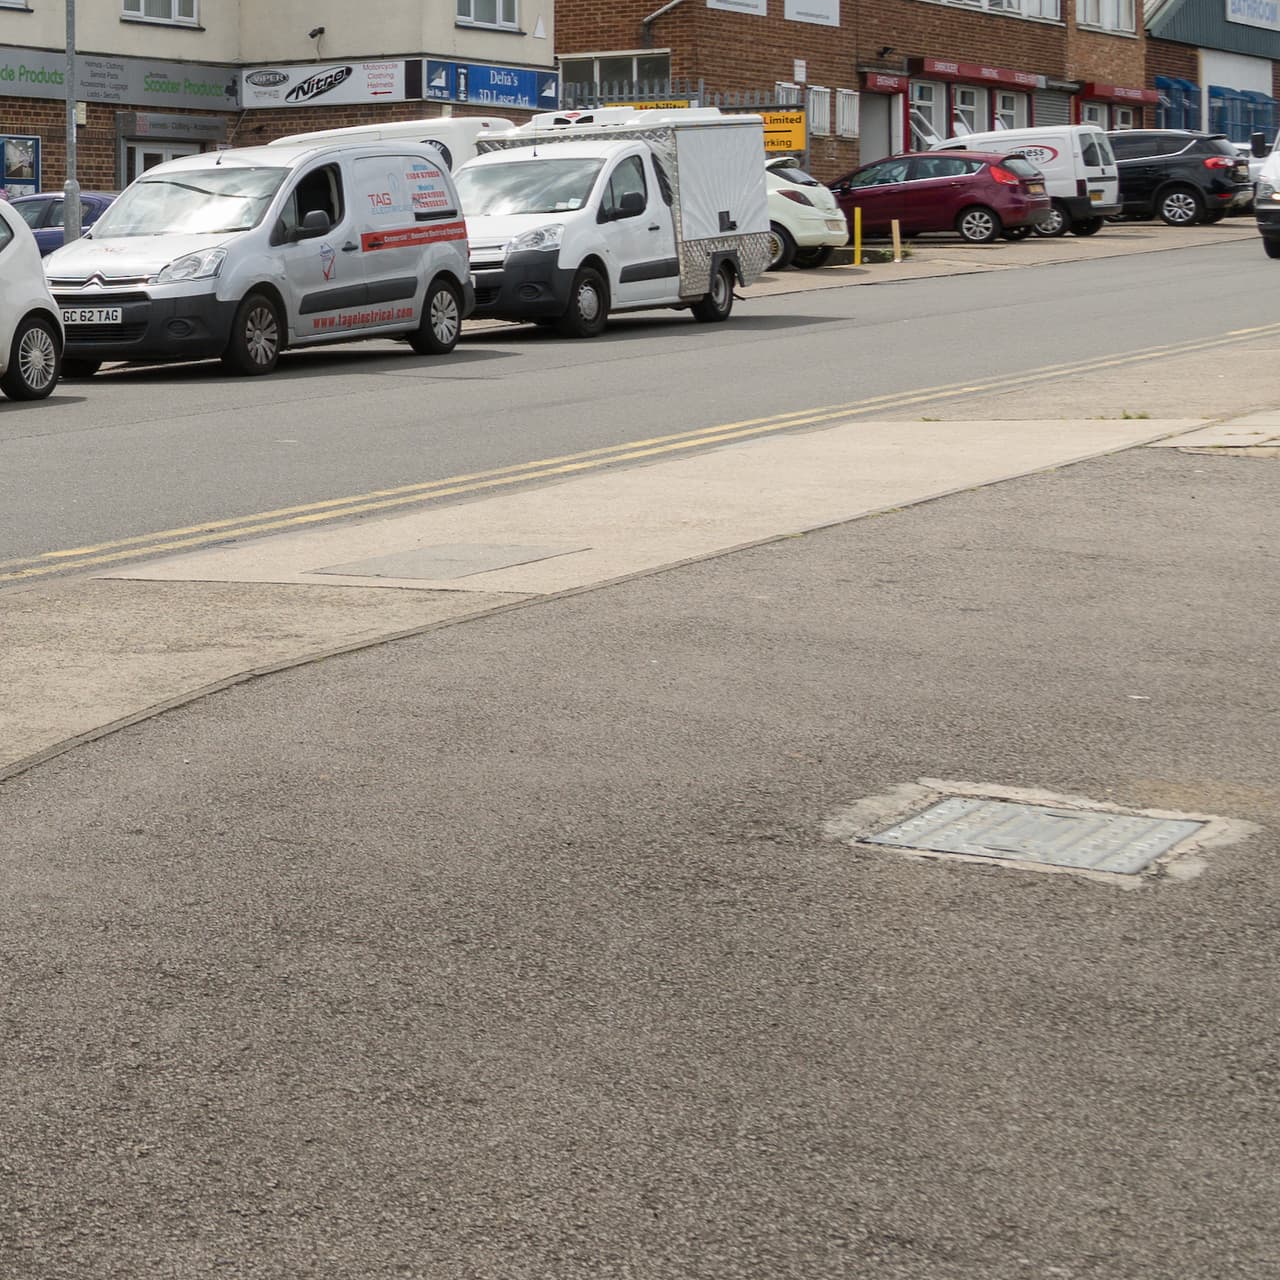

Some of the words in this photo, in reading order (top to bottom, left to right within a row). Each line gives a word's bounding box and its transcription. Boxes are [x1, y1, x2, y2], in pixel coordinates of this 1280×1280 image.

[18, 65, 64, 84] Products
[144, 75, 180, 93] Scooter
[184, 78, 224, 96] Products
[296, 69, 346, 100] Nitro
[367, 81, 394, 89] Helmets
[480, 89, 490, 104] 3D
[494, 91, 514, 105] Laser
[518, 95, 528, 106] Art
[764, 116, 802, 124] Limited
[368, 192, 392, 208] TAG
[63, 311, 77, 322] GC
[80, 311, 94, 321] 62
[98, 309, 118, 321] TAG
